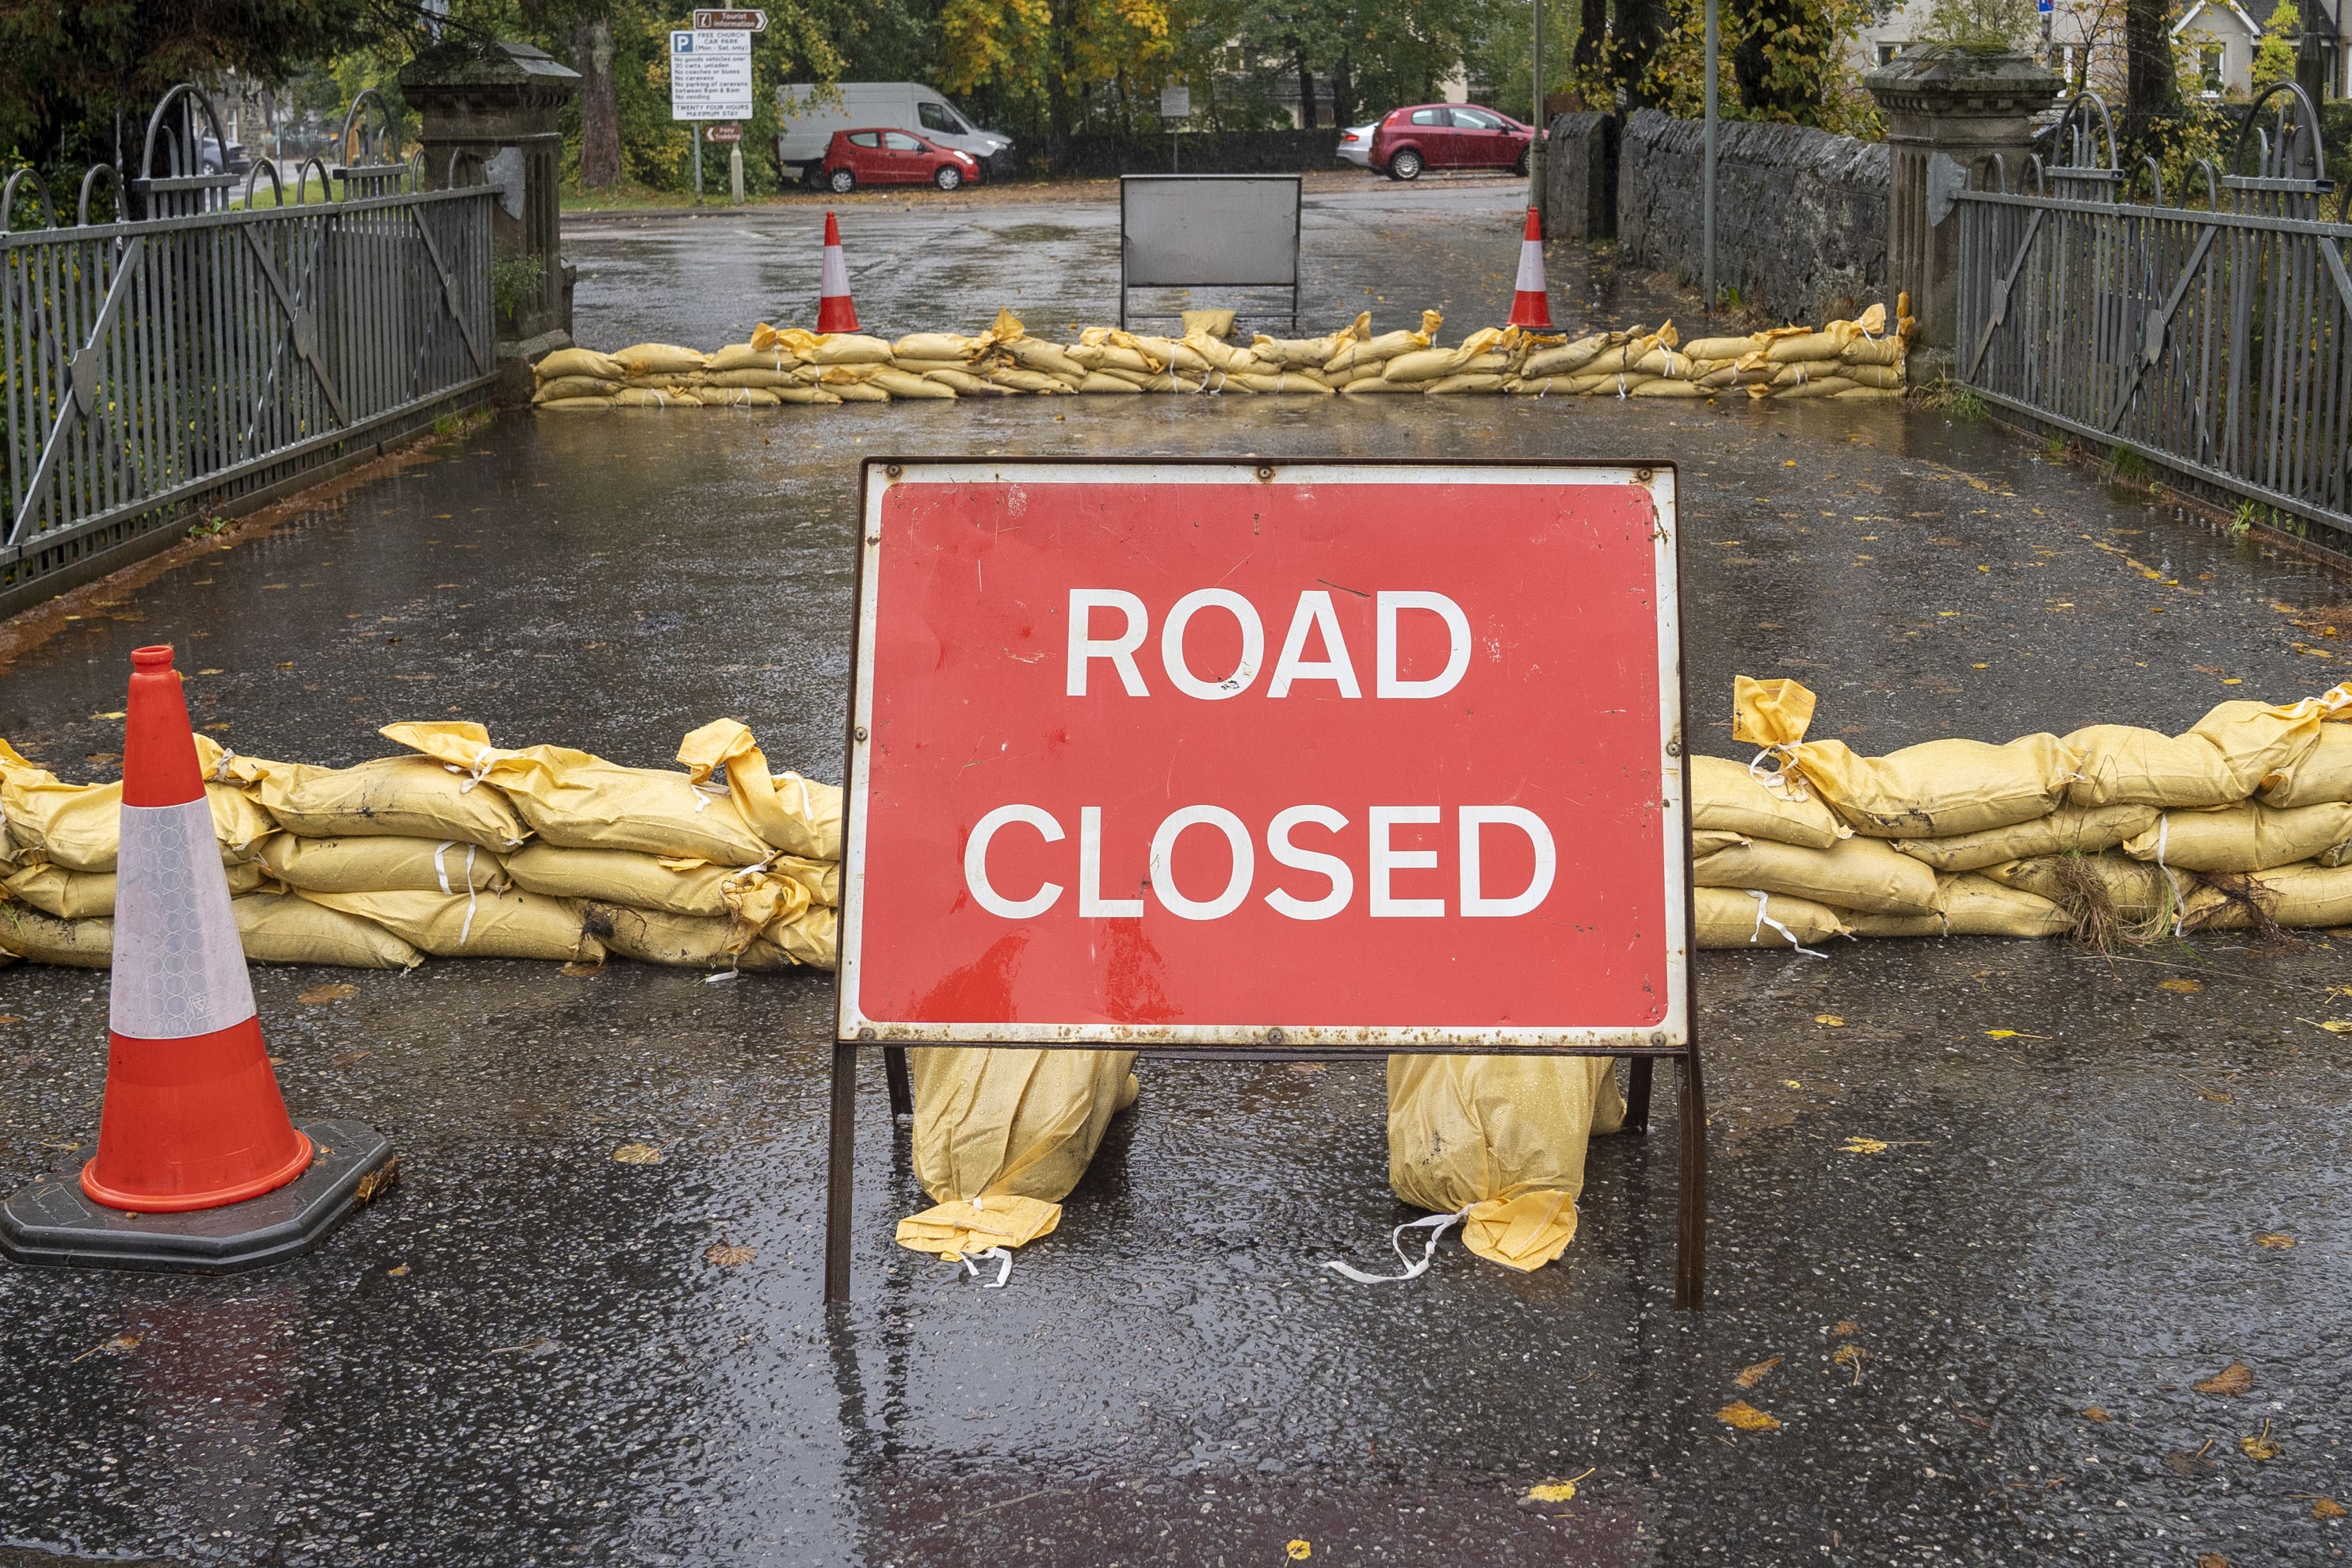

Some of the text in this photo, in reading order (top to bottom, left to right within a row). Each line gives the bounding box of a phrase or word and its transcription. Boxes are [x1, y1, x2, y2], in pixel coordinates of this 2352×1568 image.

[677, 35, 689, 52] P
[1066, 586, 1472, 700] ROAD
[963, 803, 1558, 921] CLOSED
